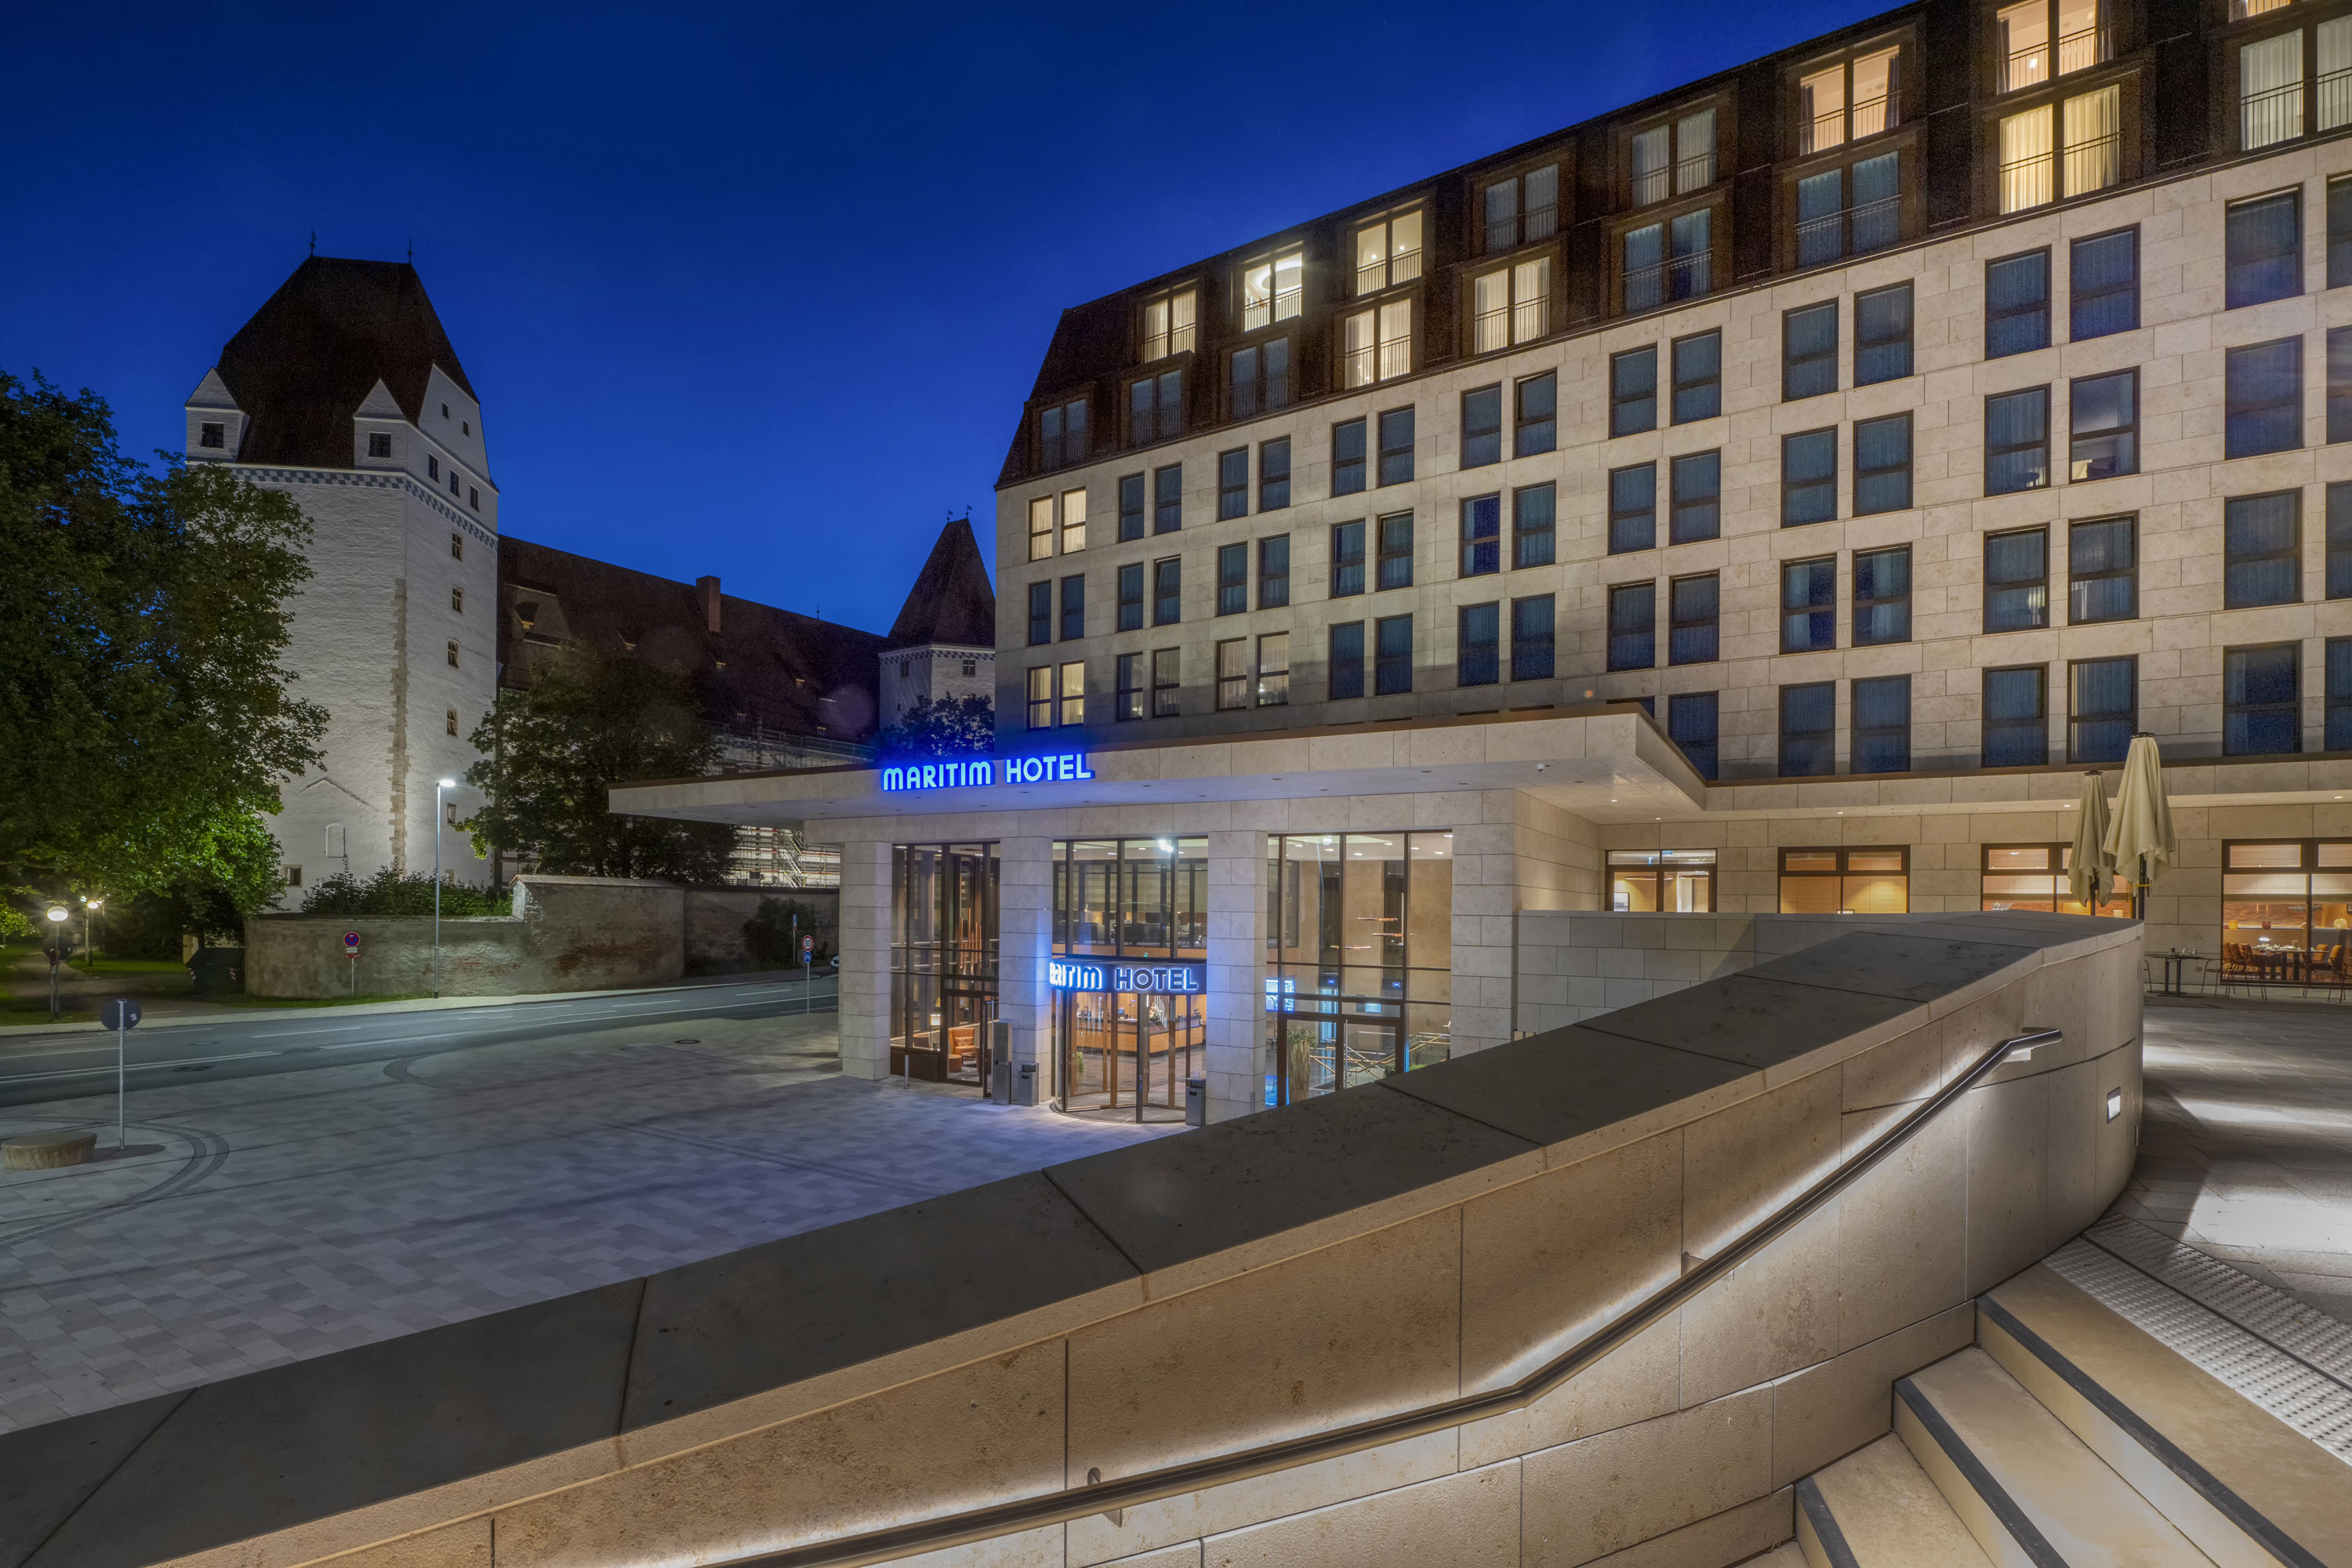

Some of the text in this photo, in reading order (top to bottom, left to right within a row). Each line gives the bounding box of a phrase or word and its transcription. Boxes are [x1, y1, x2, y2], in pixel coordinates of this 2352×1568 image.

[884, 753, 1091, 790] MARITIM HOTEL
[1115, 967, 1199, 991] HOTEL
